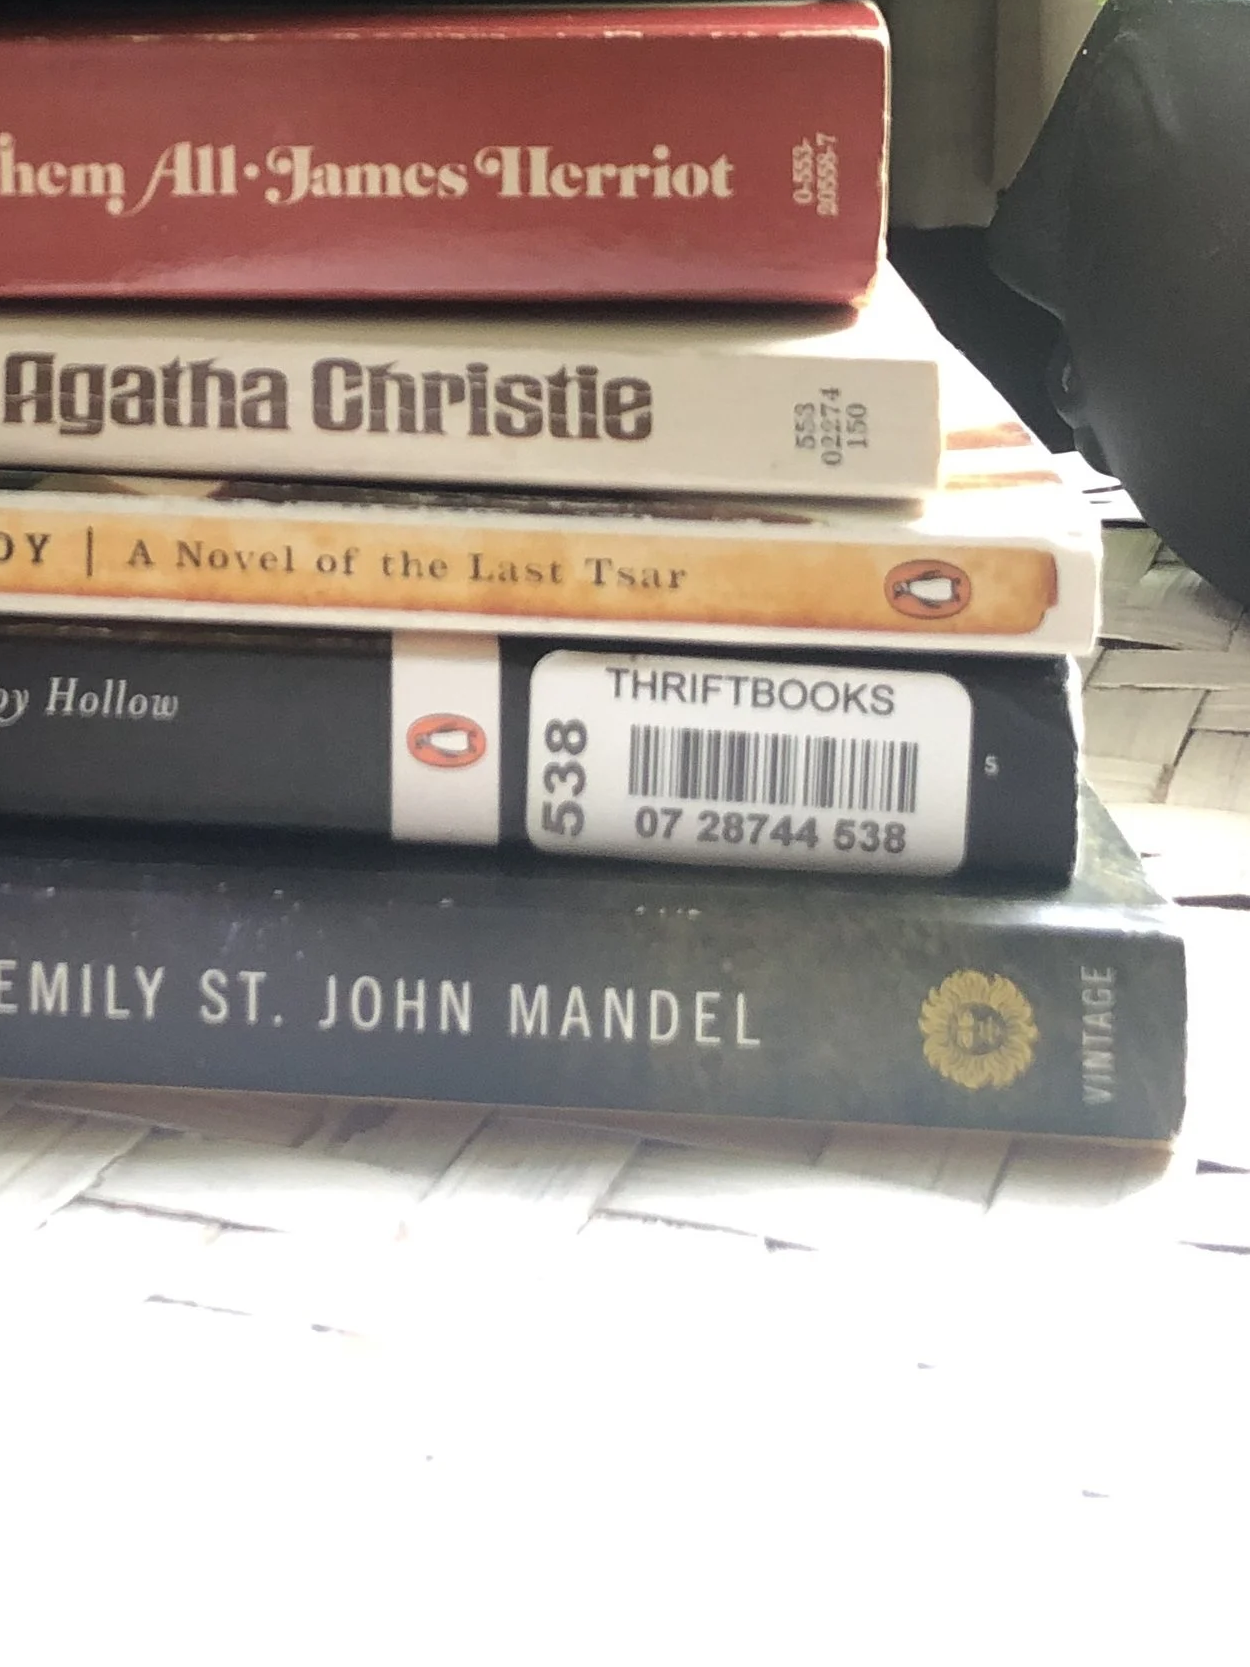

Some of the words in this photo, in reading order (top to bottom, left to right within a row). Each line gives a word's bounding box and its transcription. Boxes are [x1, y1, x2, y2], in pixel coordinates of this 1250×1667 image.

[106, 141, 238, 216] All
[265, 145, 470, 205] James
[474, 144, 735, 199] Herriot
[3, 350, 291, 435] Agatha
[311, 356, 653, 441] Christie
[793, 402, 815, 449] 553
[819, 387, 842, 465] 02274
[846, 403, 867, 448] 150
[128, 538, 154, 567] A
[176, 540, 295, 574] Novel
[316, 547, 360, 576] of
[382, 549, 449, 583] the
[468, 553, 564, 587] Last
[585, 557, 689, 591] Tsar
[45, 677, 179, 719] Hollow
[606, 668, 895, 717] THRIFTBOOKS
[543, 719, 589, 837] 538
[636, 806, 682, 840] 07
[697, 810, 819, 853] 28744
[833, 819, 907, 855] 538
[198, 968, 284, 1026] ST.
[319, 973, 472, 1036] JOHN
[509, 983, 761, 1049] MANDEL
[1081, 965, 1117, 1105] VINTAGE
